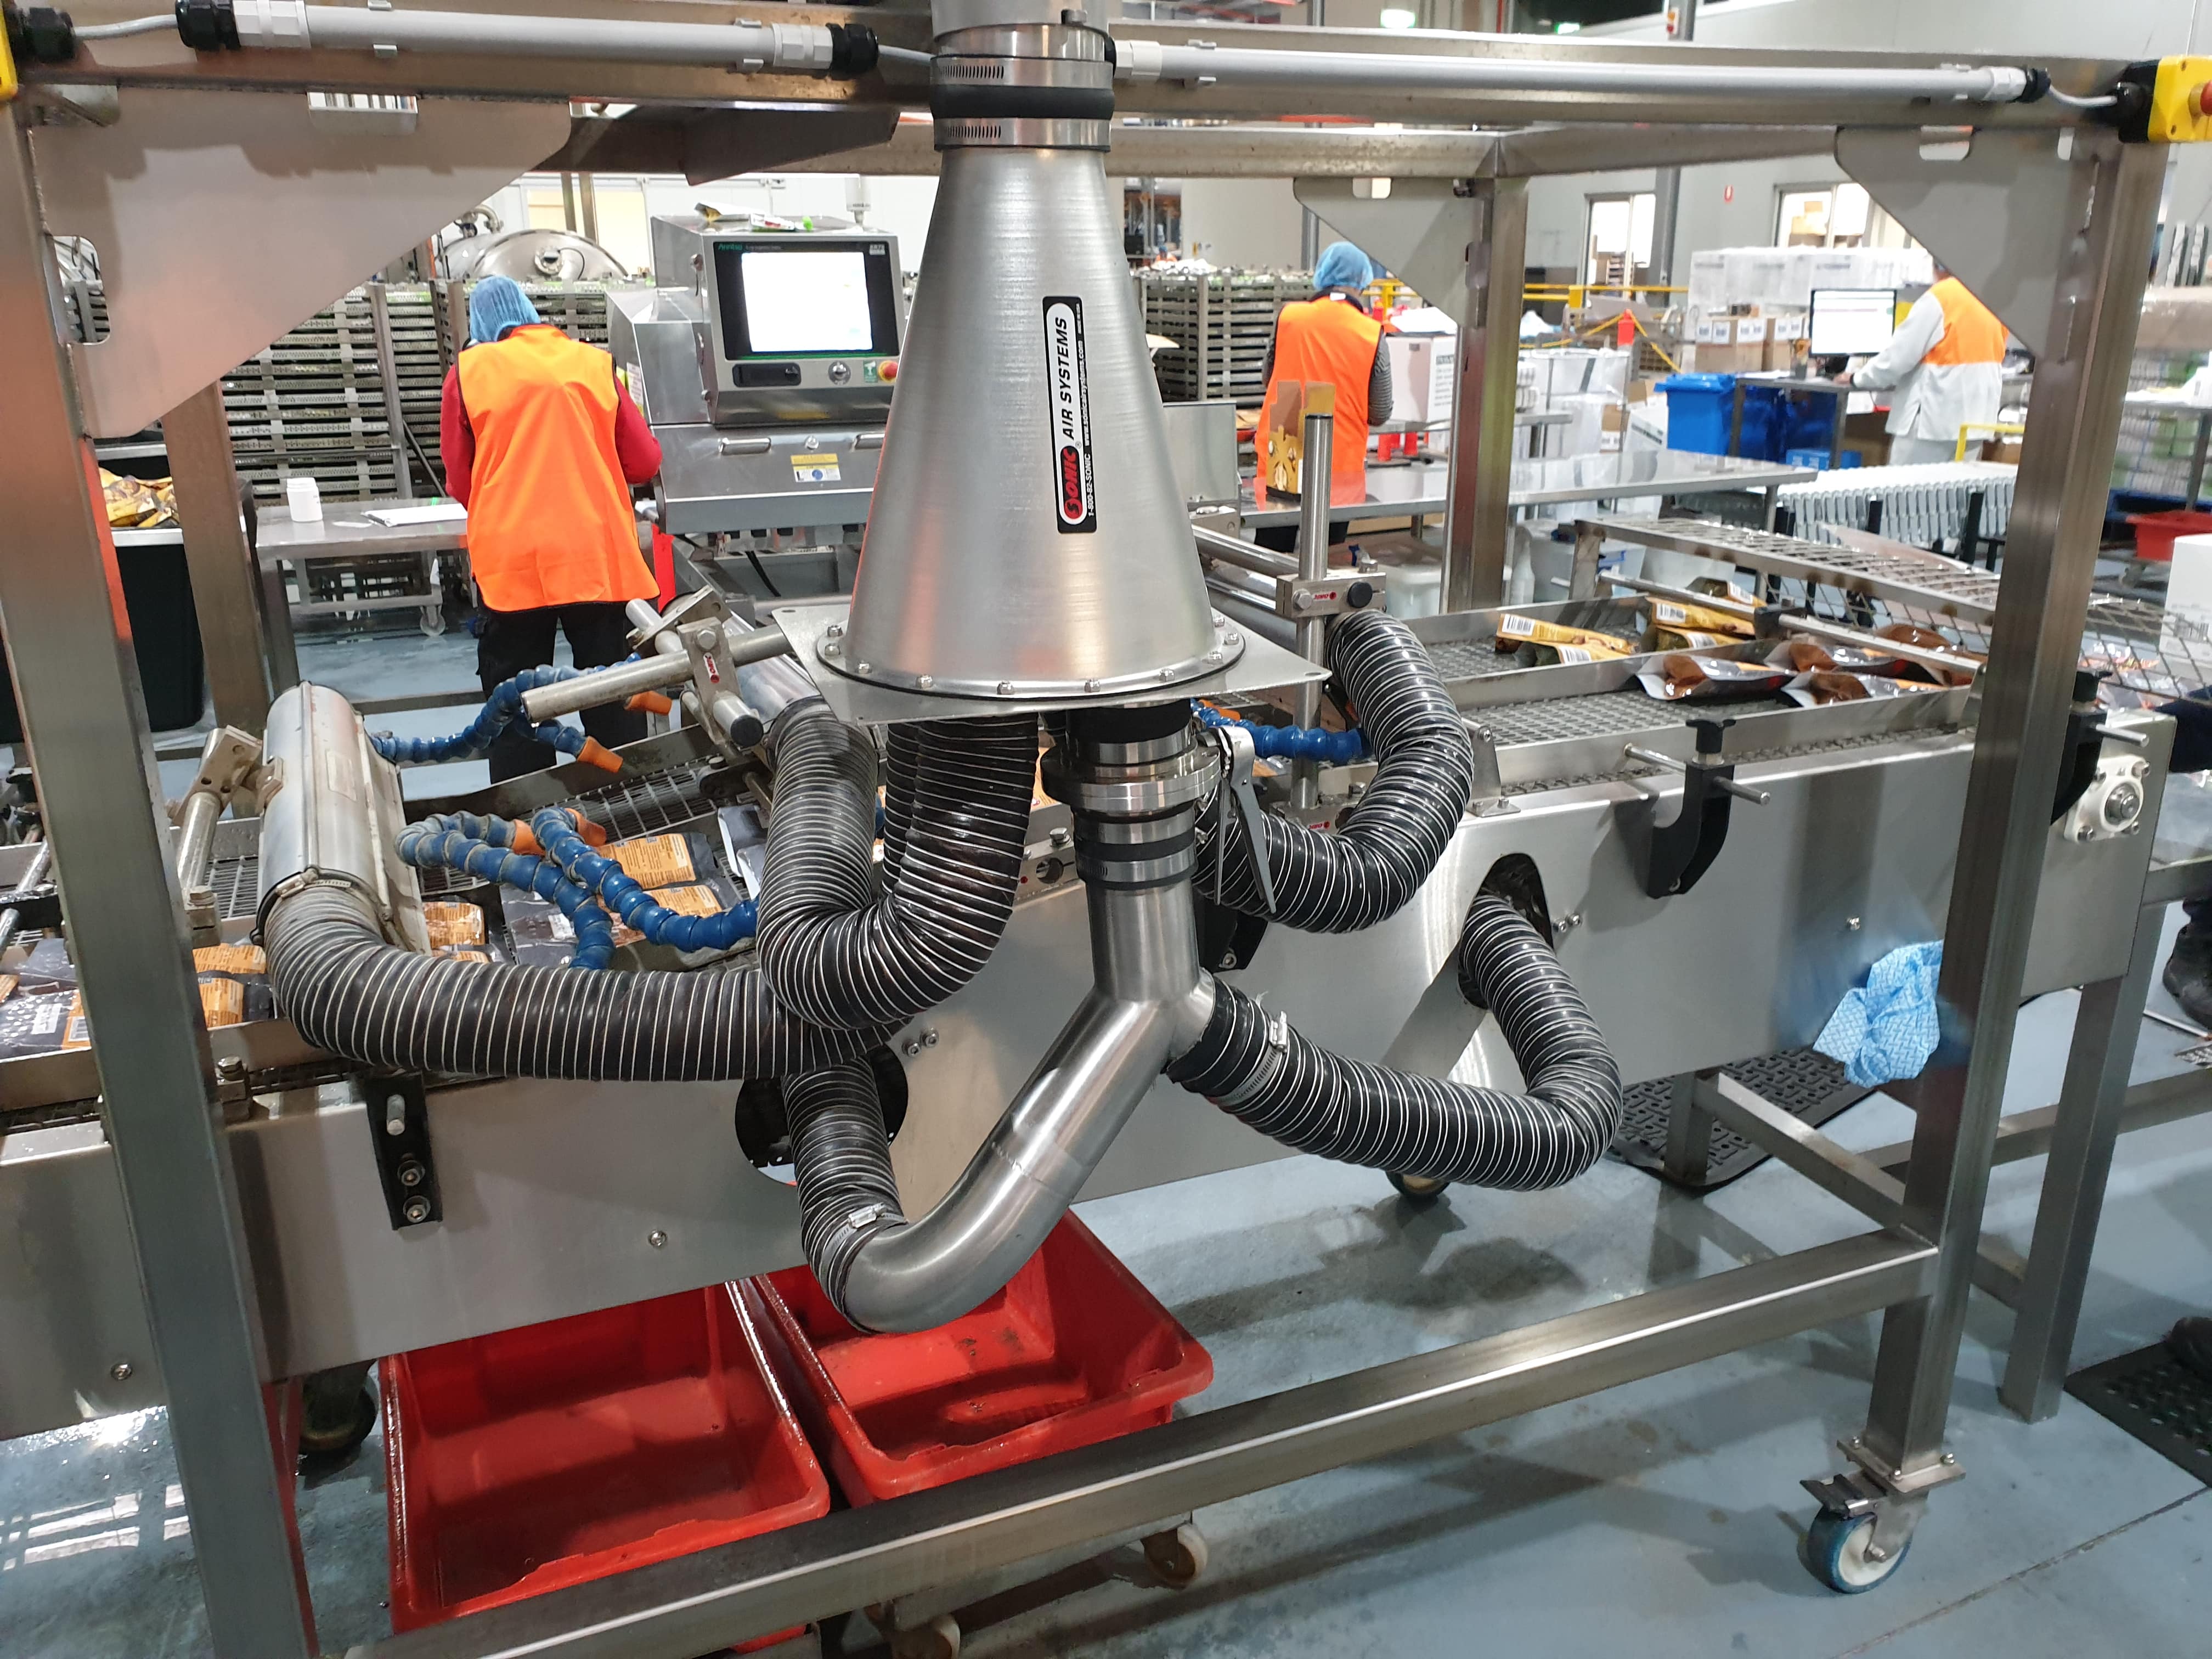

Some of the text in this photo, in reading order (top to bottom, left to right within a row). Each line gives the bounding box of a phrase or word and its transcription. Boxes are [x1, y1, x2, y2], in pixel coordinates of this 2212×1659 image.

[1055, 317, 1083, 519] SONIC AIR SYSTEMS
[1078, 340, 1090, 446] www.sonicairsystems.com
[1085, 453, 1094, 516] 1-800-82-SONIC
